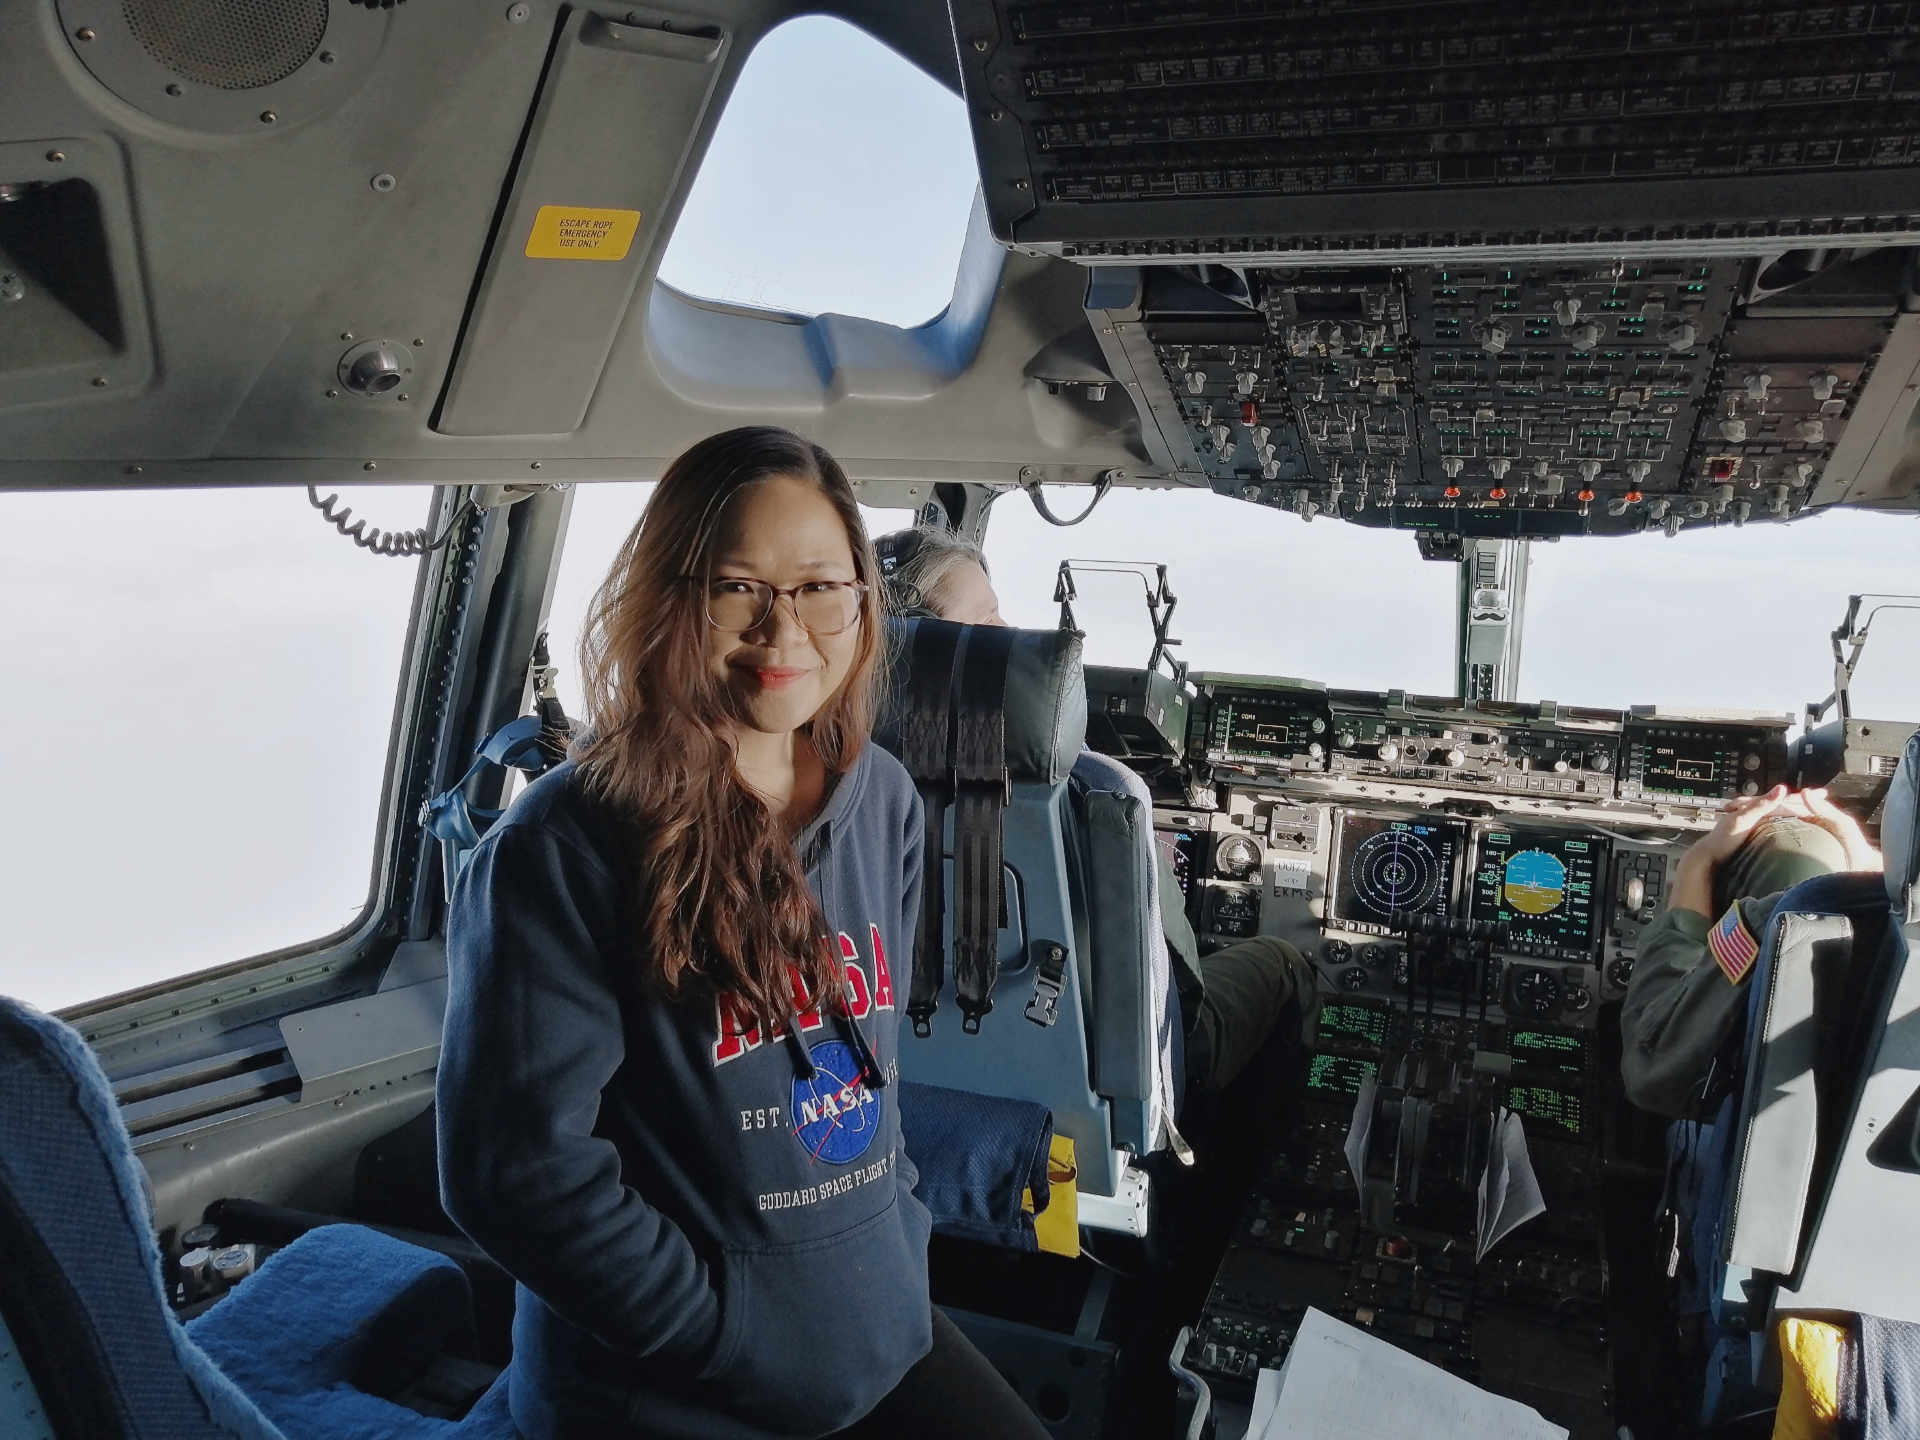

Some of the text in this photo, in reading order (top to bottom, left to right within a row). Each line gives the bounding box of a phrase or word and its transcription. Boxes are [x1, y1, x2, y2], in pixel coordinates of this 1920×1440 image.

[559, 218, 615, 230] ESCAPE ROPE
[559, 229, 608, 239] EMERGENCY
[559, 239, 576, 247] USE
[1677, 770, 1700, 778] 119.4
[1273, 886, 1314, 902] EKMS
[801, 1083, 874, 1126] NASA
[741, 1107, 789, 1130] EST.
[758, 1187, 818, 1211] GODDARD
[819, 1173, 853, 1200] SPACE
[854, 1157, 889, 1187] FLIGHT
